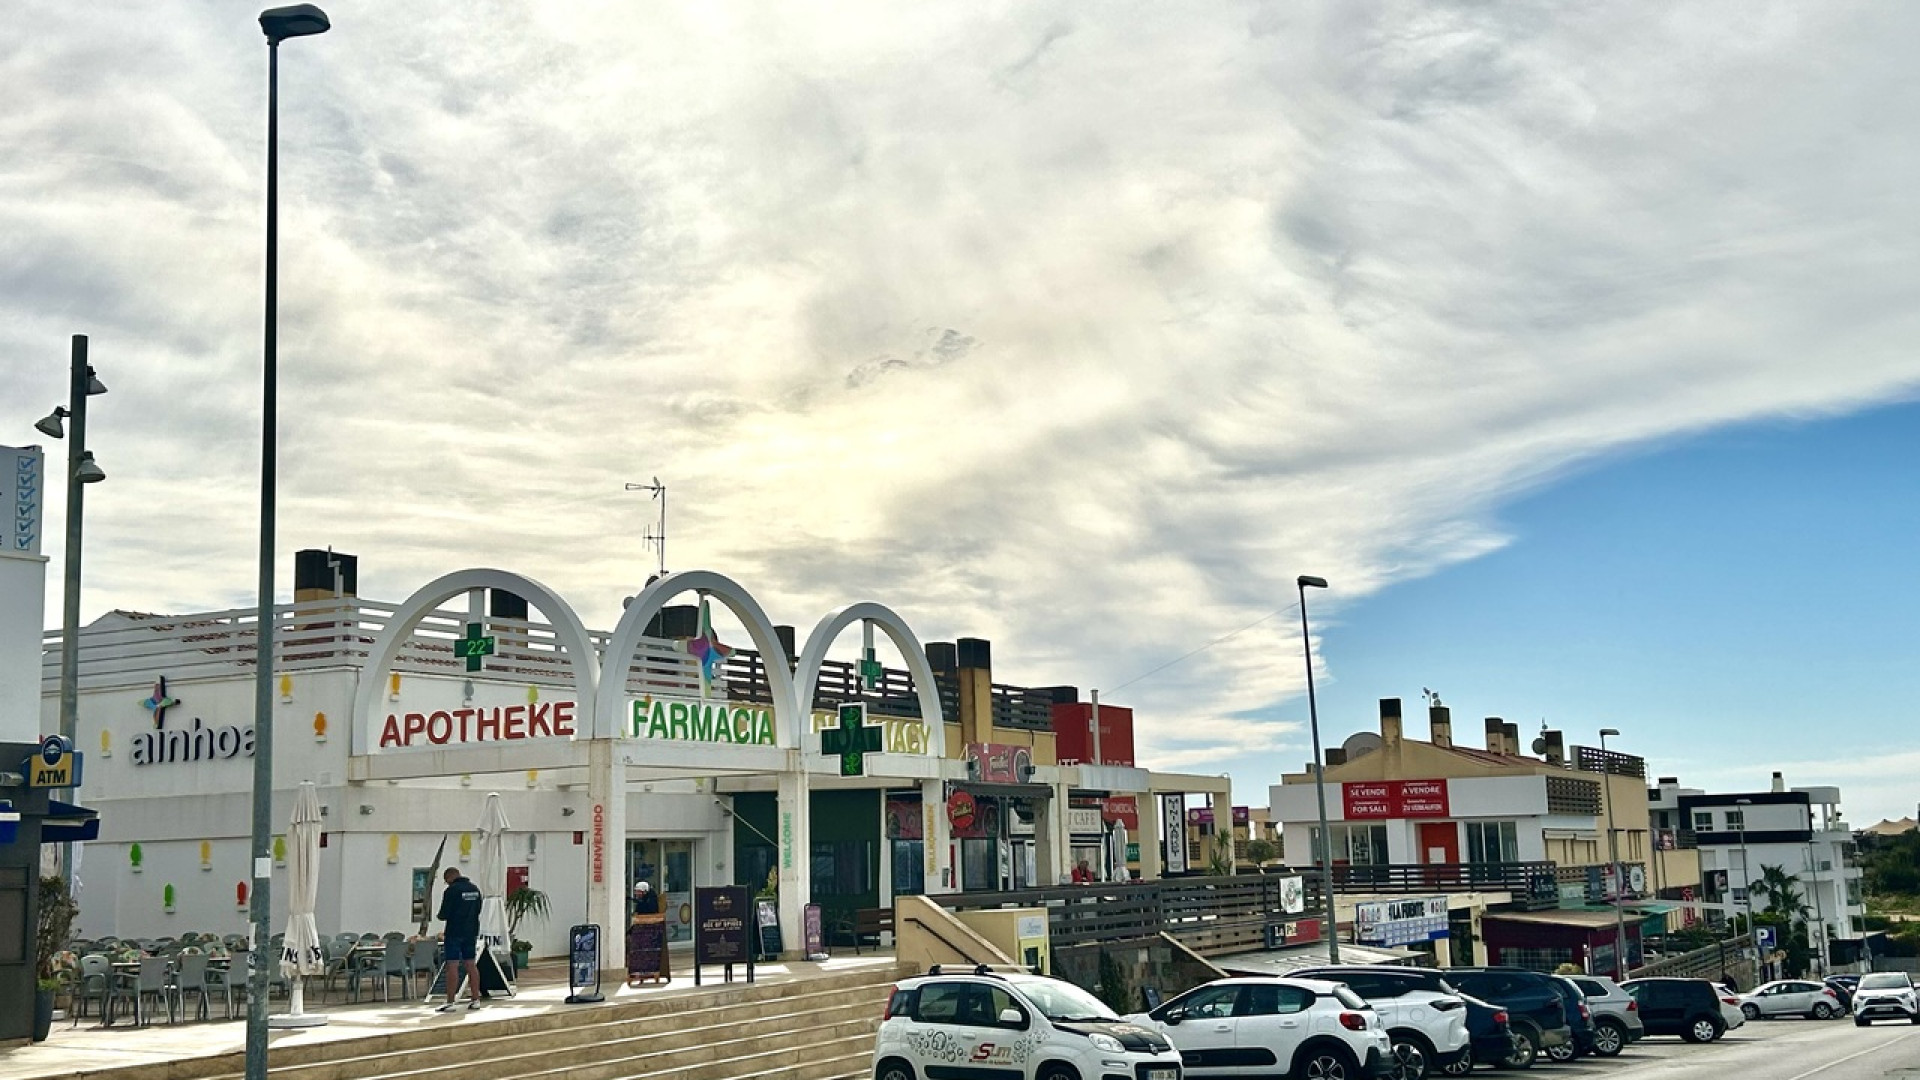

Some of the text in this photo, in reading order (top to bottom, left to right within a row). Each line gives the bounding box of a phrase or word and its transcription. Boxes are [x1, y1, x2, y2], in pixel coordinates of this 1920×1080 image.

[379, 701, 576, 748] APOTHEKE
[629, 699, 775, 746] FARMACIA
[130, 716, 256, 766] ainhoa
[36, 769, 66, 784] ATM
[1350, 787, 1387, 796] SE VENDE
[1168, 797, 1180, 820] MINI
[1352, 804, 1387, 814] FOR SALE
[593, 804, 603, 883] BIENVENIDO
[782, 812, 792, 869] WELCOME
[1756, 928, 1769, 946] P
